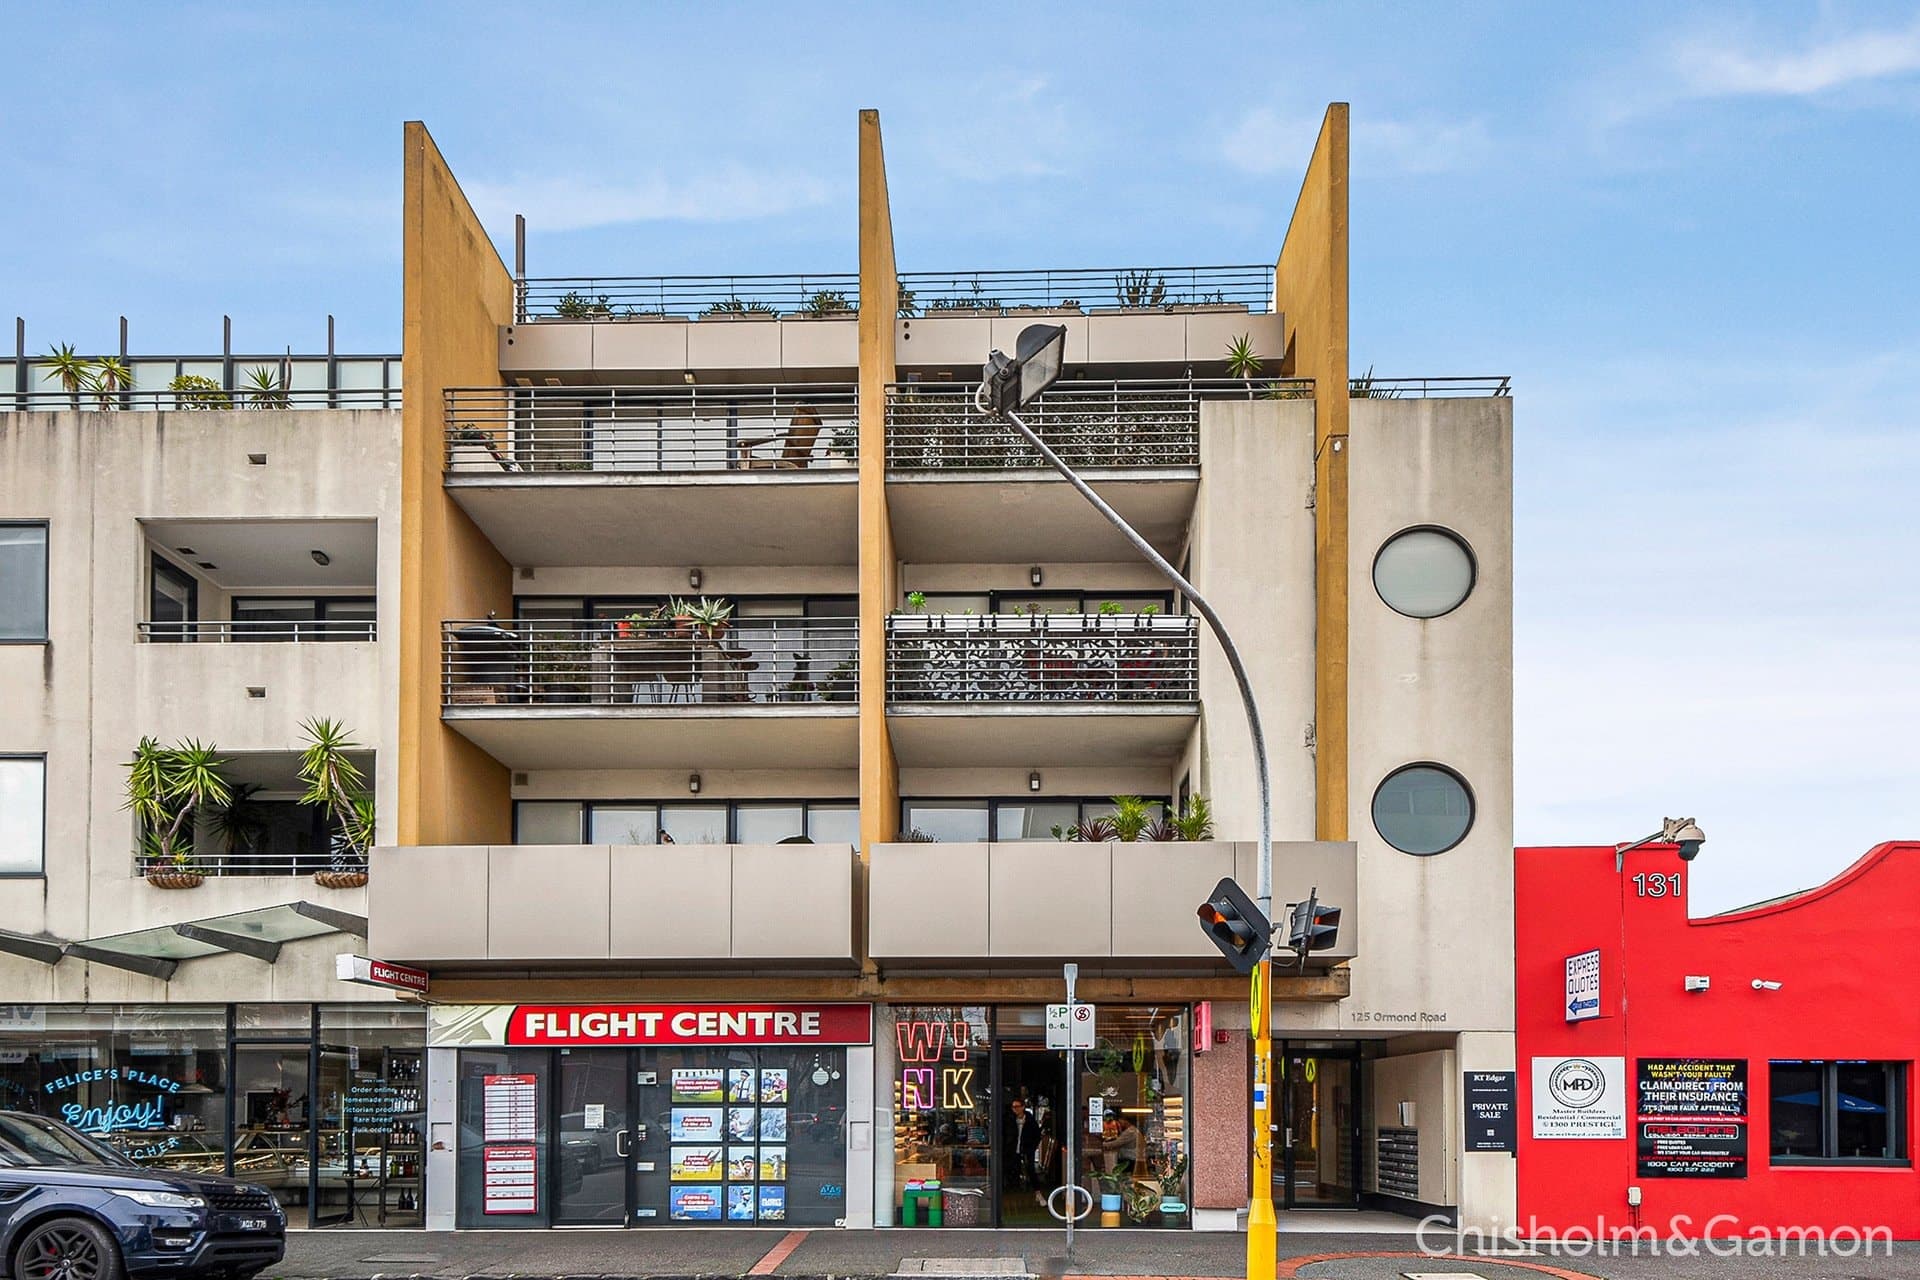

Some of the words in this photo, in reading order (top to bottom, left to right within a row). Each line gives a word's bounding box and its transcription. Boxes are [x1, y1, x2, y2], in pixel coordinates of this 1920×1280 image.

[1632, 873, 1681, 897] 131
[1568, 954, 1598, 976] EXPRESS
[374, 966, 399, 980] FLIGHT
[400, 973, 425, 986] CENTRE
[1569, 974, 1598, 994] QUOTES
[1351, 1012, 1370, 1022] 125
[1373, 1012, 1417, 1022] Ormond
[1420, 1012, 1447, 1022] Road
[525, 1011, 663, 1037] FLIGHT
[671, 1011, 821, 1037] CENTRE
[45, 1067, 118, 1094] FELICE'S
[128, 1070, 181, 1094] PLACE
[1485, 1074, 1506, 1083] Edgar
[1563, 1078, 1594, 1091] MPD
[1640, 1081, 1673, 1091] CLAIM
[1675, 1081, 1711, 1091] DIRECT
[1713, 1081, 1744, 1091] FROM
[1646, 1091, 1677, 1101] THEIR
[1679, 1092, 1738, 1101] INSURANCE
[1472, 1103, 1508, 1111] PRIVATE
[61, 1095, 164, 1133] Enjoy!
[1479, 1111, 1501, 1119] SALE
[1647, 1126, 1735, 1135] MELBOURNE
